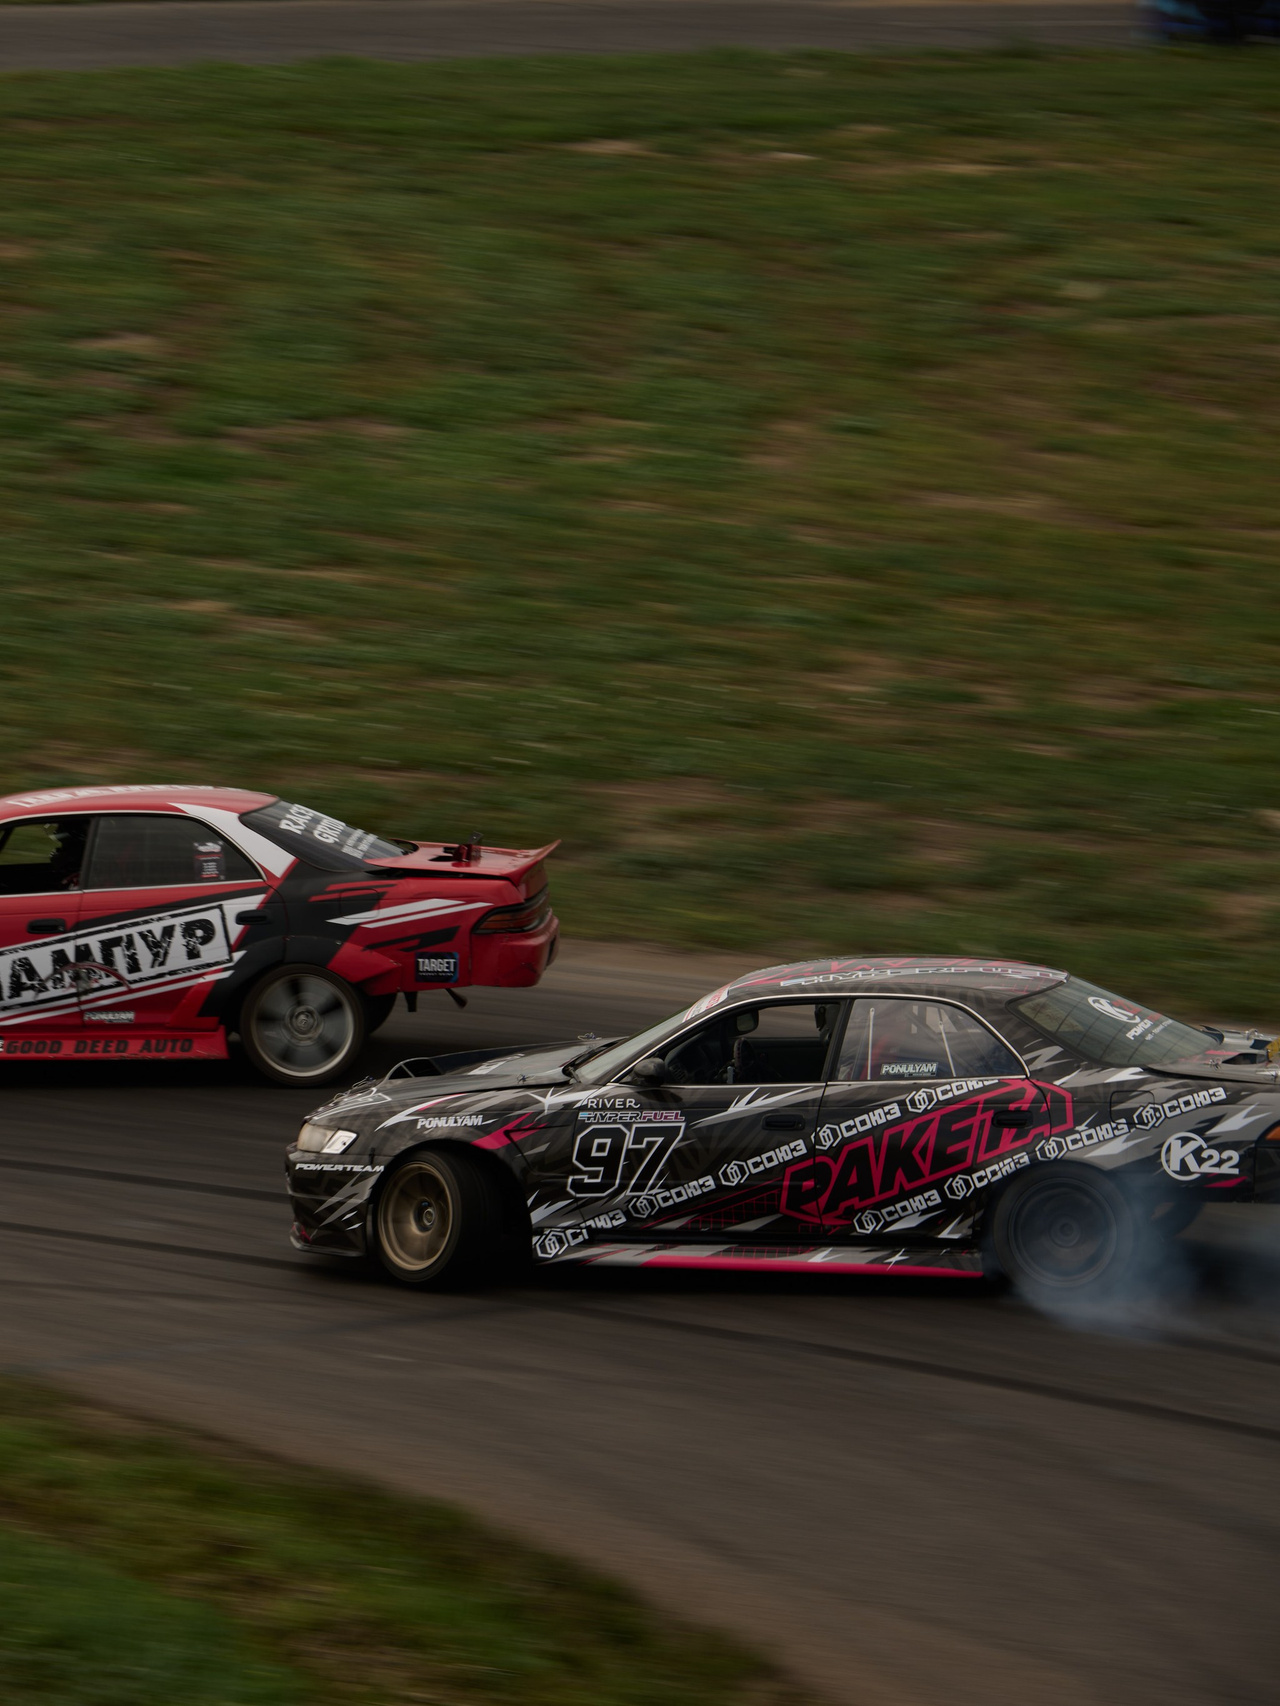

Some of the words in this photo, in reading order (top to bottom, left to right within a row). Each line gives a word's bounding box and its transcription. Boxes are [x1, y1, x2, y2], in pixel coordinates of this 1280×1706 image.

[417, 958, 456, 972] TARGET
[6, 1040, 62, 1053] GOOD
[74, 1040, 129, 1052] DEED
[140, 1038, 193, 1052] AUTO
[882, 1063, 937, 1074] PONULYAM
[587, 1098, 641, 1109] RIVER
[417, 1115, 483, 1129] PONULYAM
[582, 1110, 685, 1123] HYPERFUEL
[566, 1122, 686, 1197] 97
[658, 1175, 716, 1209] СОЮЗ
[747, 1139, 807, 1175] СОЮЗ
[842, 1103, 901, 1139] СОЮЗ
[881, 1188, 942, 1222] СОЮЗ
[1068, 1118, 1129, 1151] СОЮЗ
[1163, 1087, 1227, 1118] СОЮЗ
[1164, 1134, 1240, 1179] K22
[295, 1163, 385, 1173] POWERTEAM
